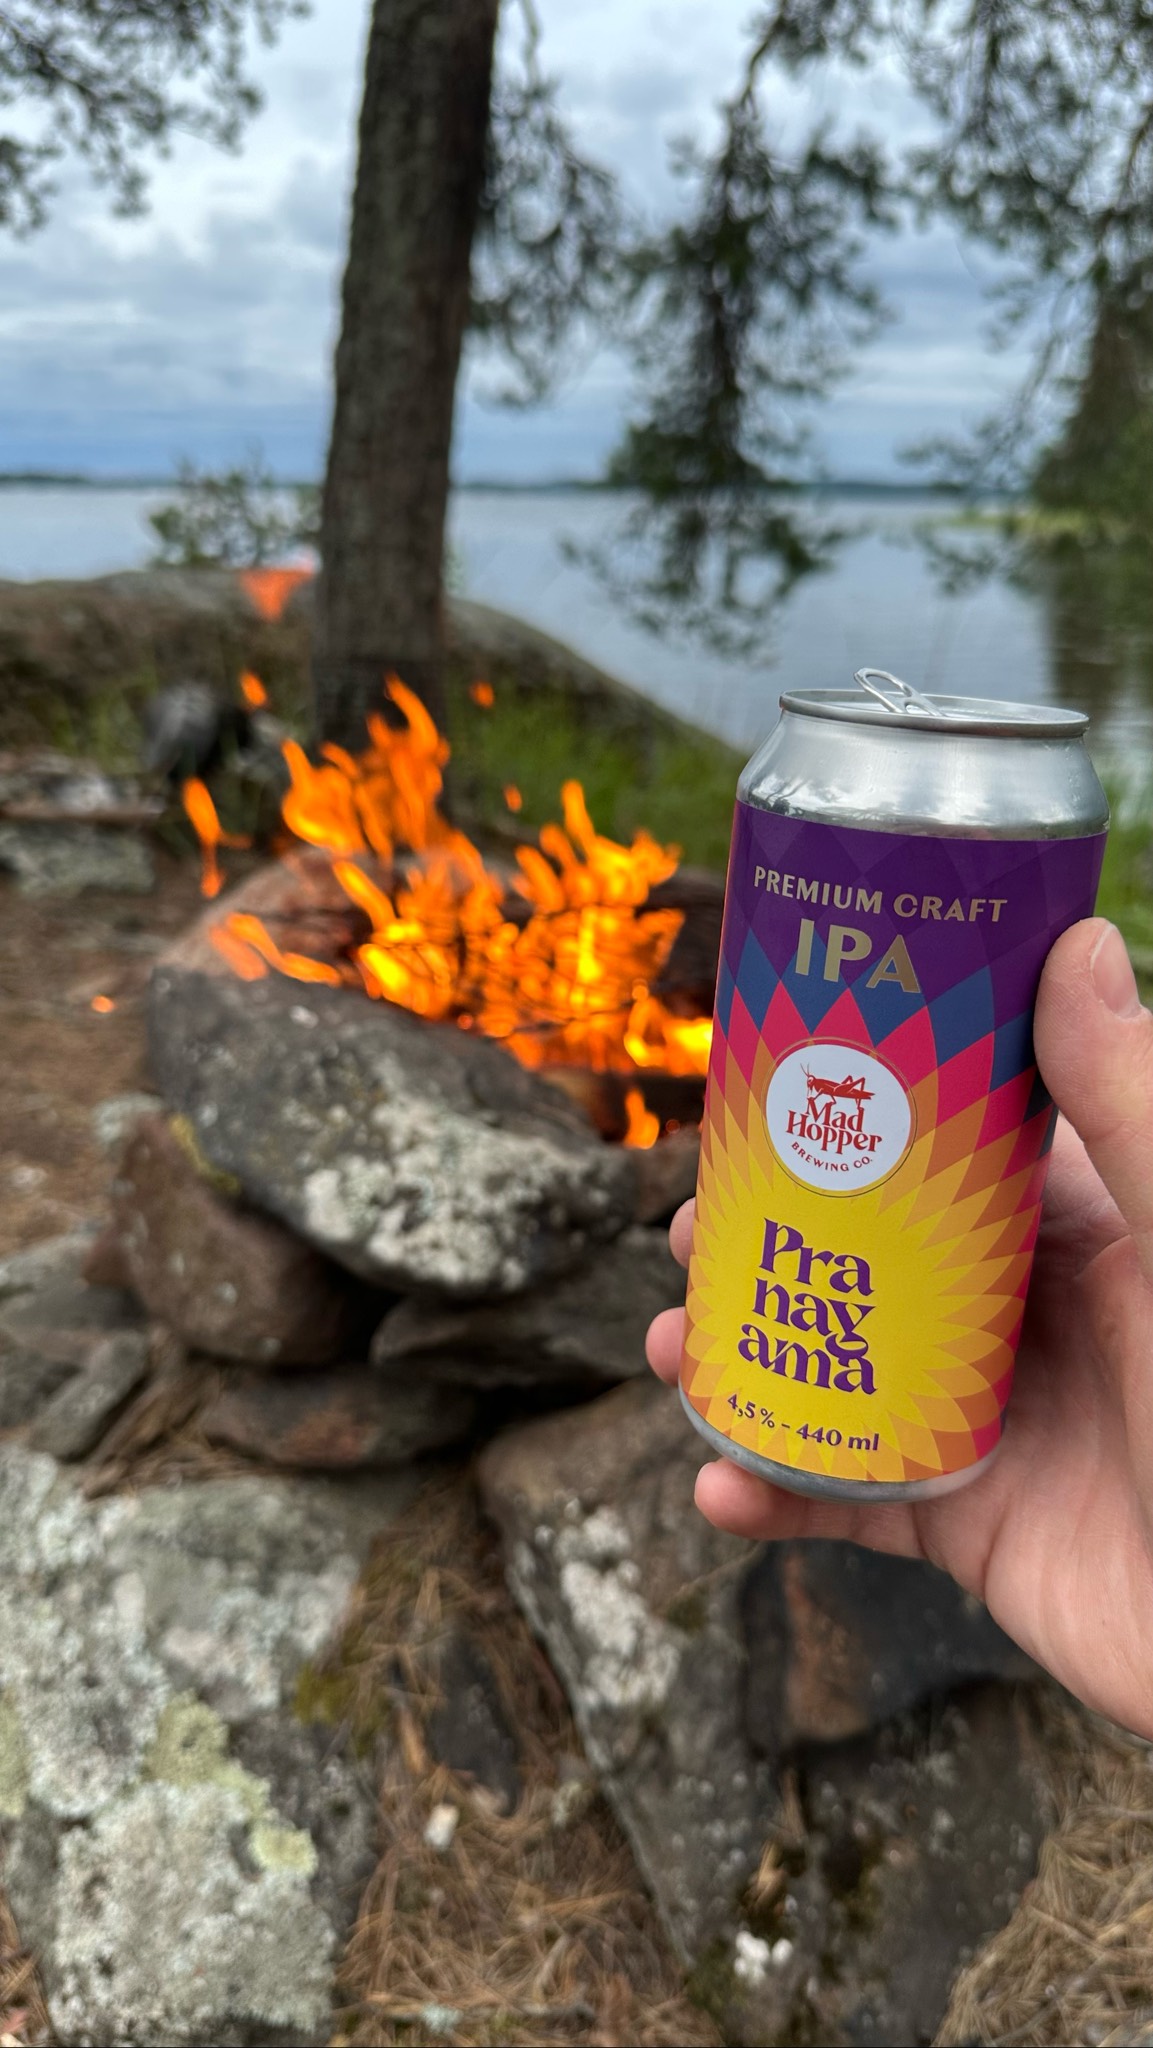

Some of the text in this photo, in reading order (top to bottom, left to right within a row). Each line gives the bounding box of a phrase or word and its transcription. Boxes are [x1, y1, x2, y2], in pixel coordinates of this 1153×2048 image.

[753, 865, 1008, 922] PREMIUM CRAFT
[795, 918, 921, 994] IPA
[786, 1110, 883, 1155] Hopper
[806, 1097, 865, 1132] Mad
[791, 1141, 849, 1172] BREWING
[759, 1217, 876, 1297] Pra
[752, 1277, 876, 1361] nay
[737, 1323, 878, 1396] ama
[796, 1423, 842, 1447] 440
[848, 1433, 880, 1451] ml
